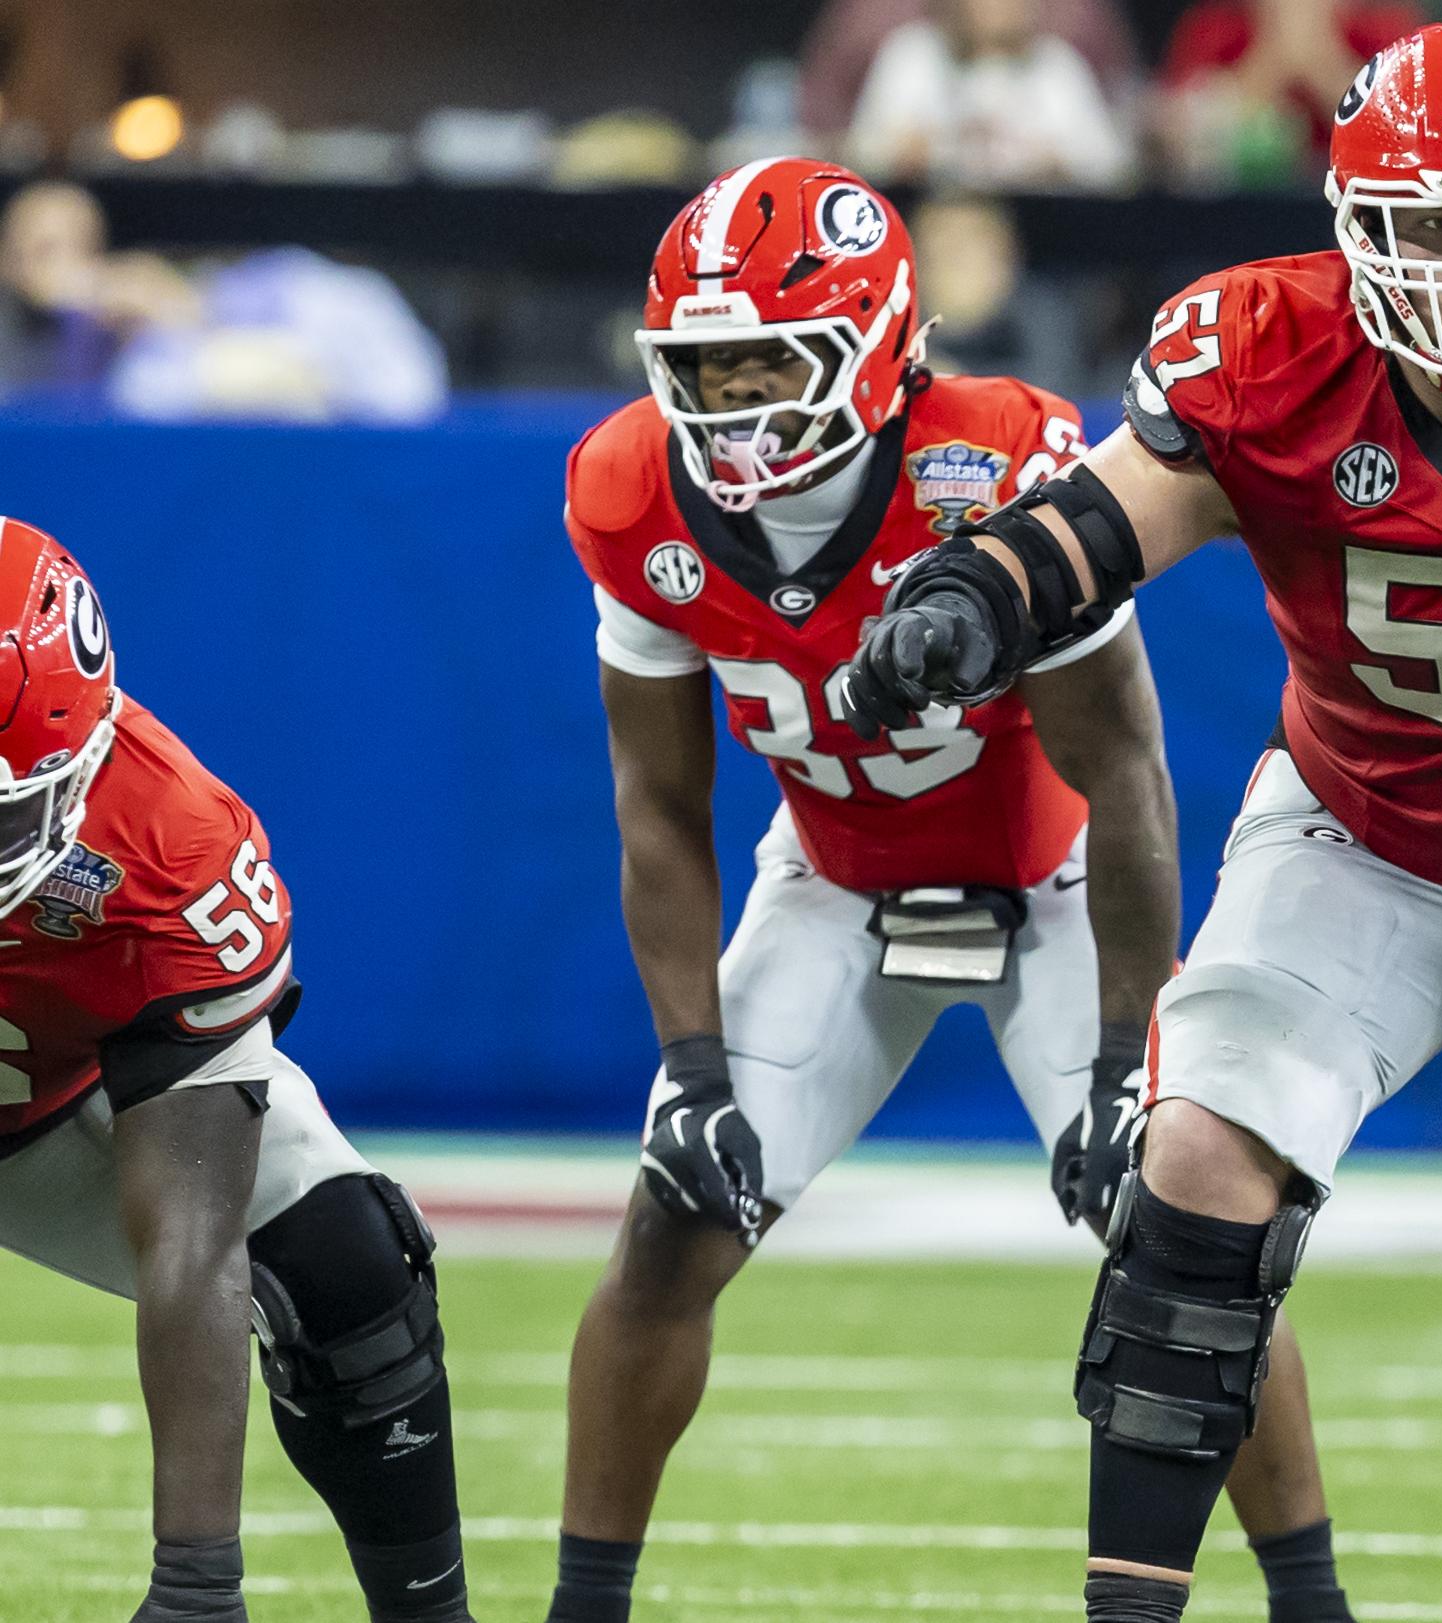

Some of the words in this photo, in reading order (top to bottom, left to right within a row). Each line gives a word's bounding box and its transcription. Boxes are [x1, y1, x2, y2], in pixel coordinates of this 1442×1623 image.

[922, 461, 992, 480] Allstate
[1341, 447, 1392, 503] SEC
[649, 543, 702, 600] SEC
[53, 862, 102, 889] state
[181, 839, 279, 973] 56
